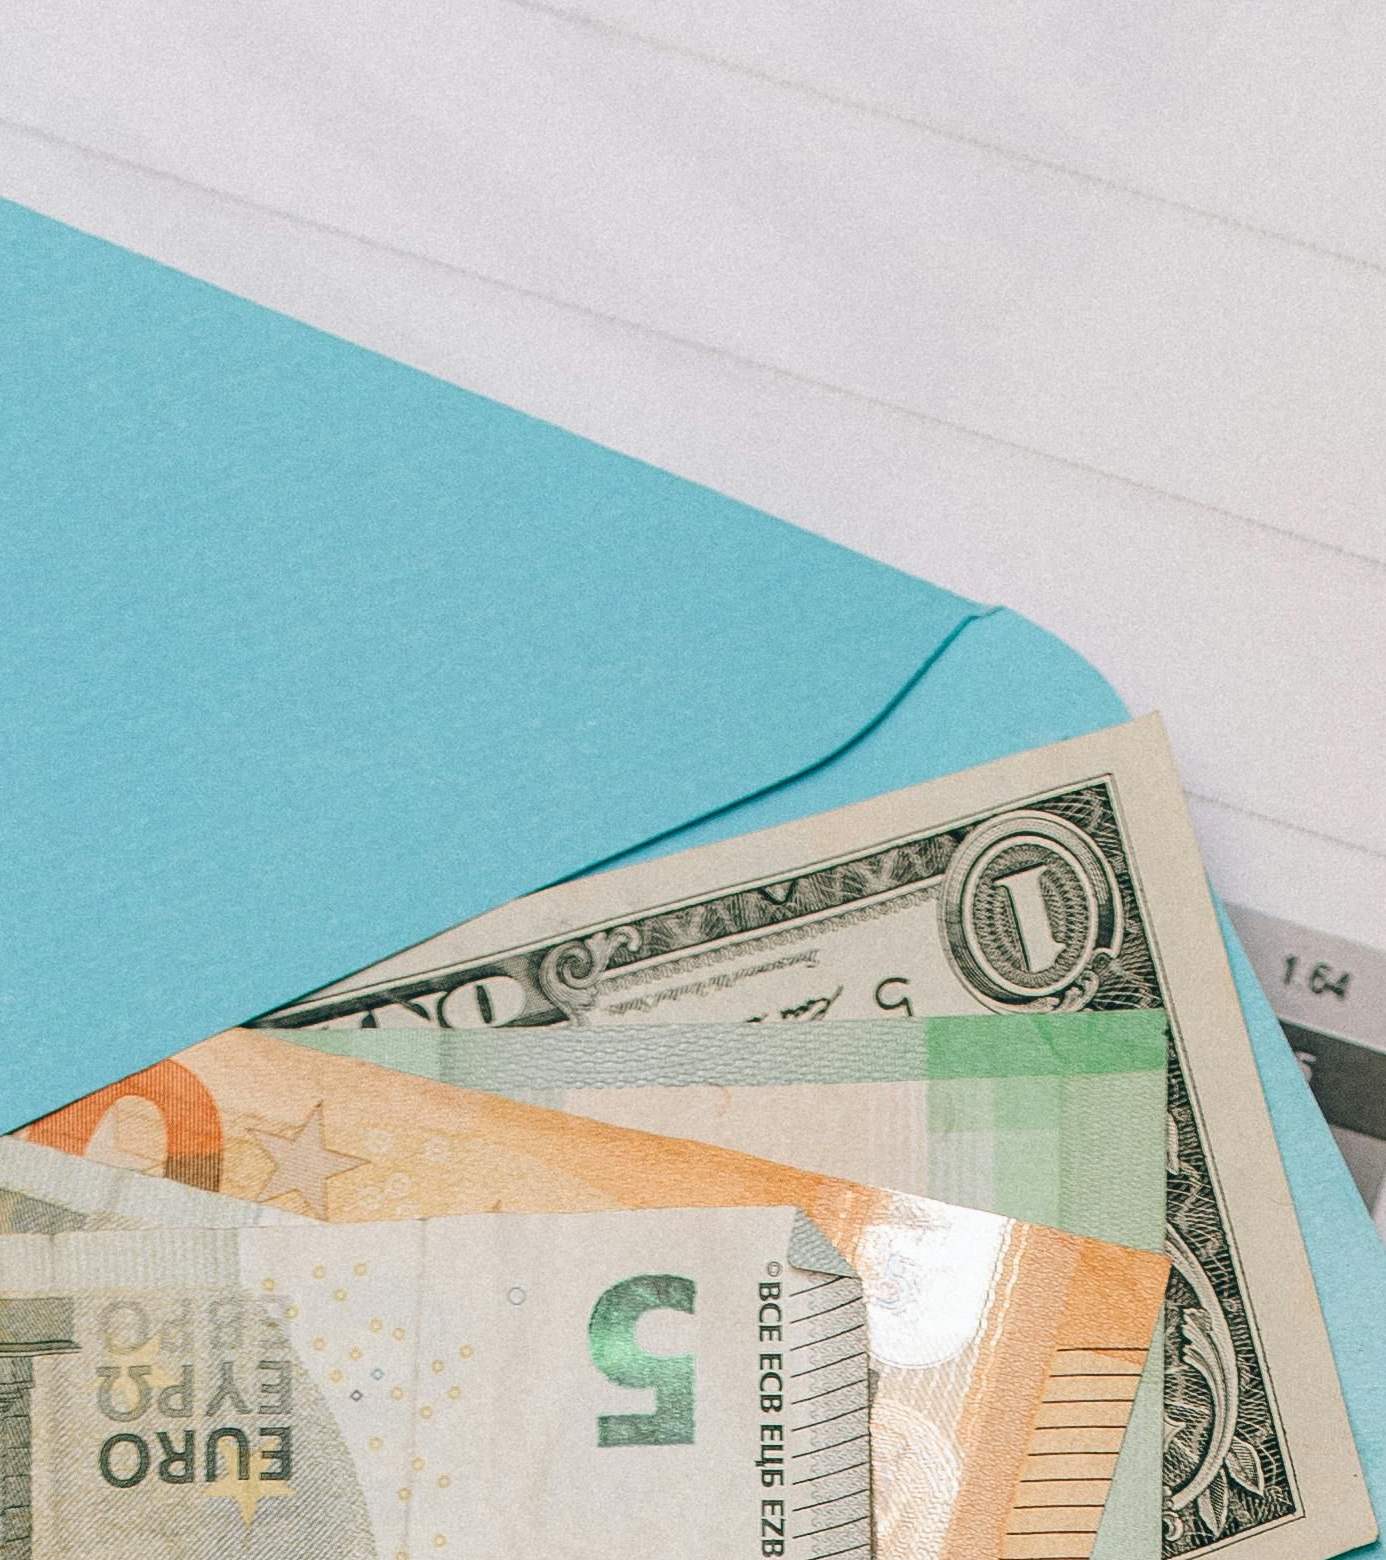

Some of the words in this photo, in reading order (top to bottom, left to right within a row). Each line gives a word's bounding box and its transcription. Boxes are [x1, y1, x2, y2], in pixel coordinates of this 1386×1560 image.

[586, 1271, 697, 1448] 5
[758, 1351, 783, 1413] ECB
[98, 1426, 292, 1489] EURO
[760, 1498, 785, 1560] EZB
